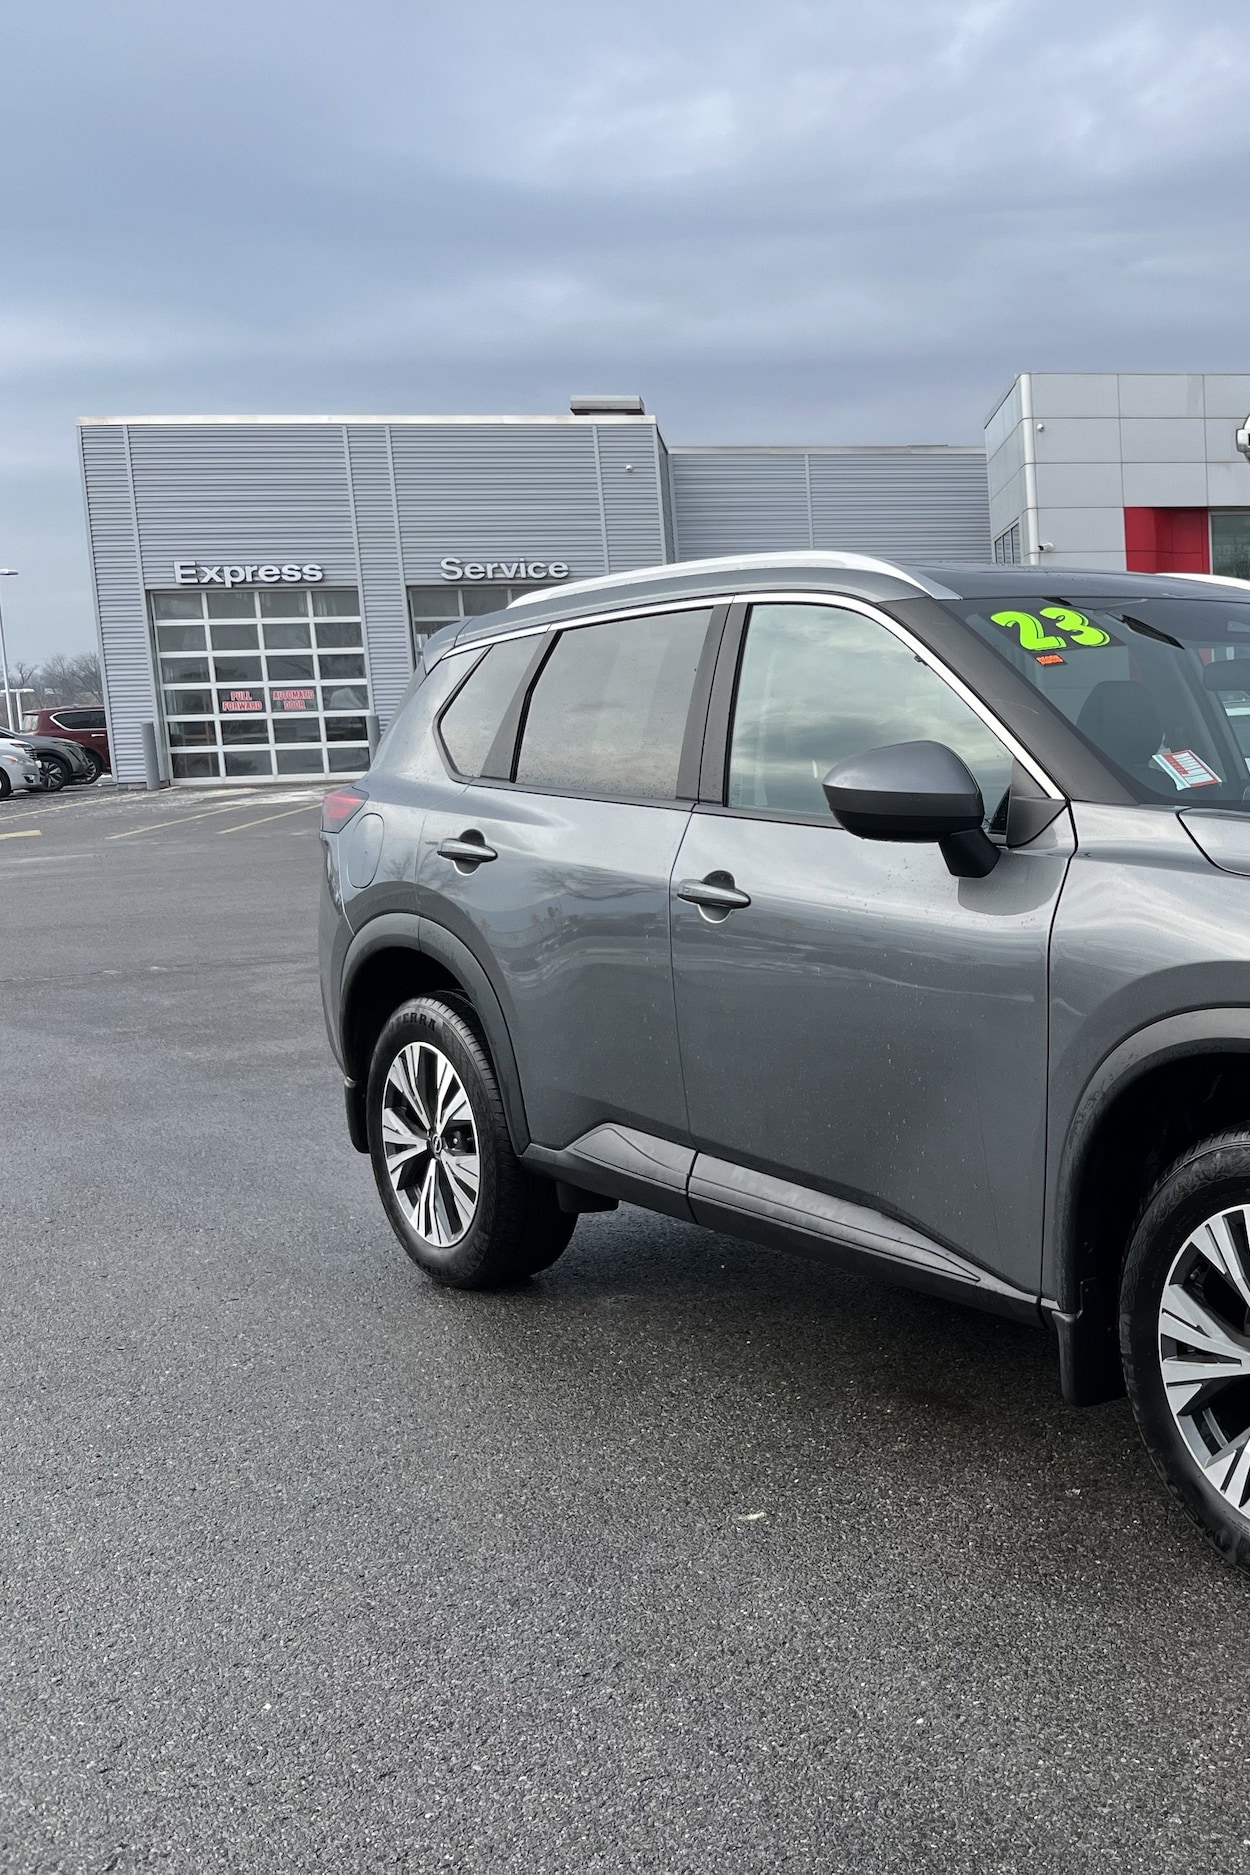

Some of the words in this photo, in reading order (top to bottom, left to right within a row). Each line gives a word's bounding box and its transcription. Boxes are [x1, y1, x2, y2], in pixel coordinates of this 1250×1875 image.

[173, 561, 324, 588] Express
[440, 557, 569, 580] Service
[990, 606, 1111, 651] 23
[230, 690, 252, 701] PULL
[272, 689, 315, 700] AUTOMATIC
[222, 701, 262, 711] FORWARD
[283, 700, 306, 711] DOOR
